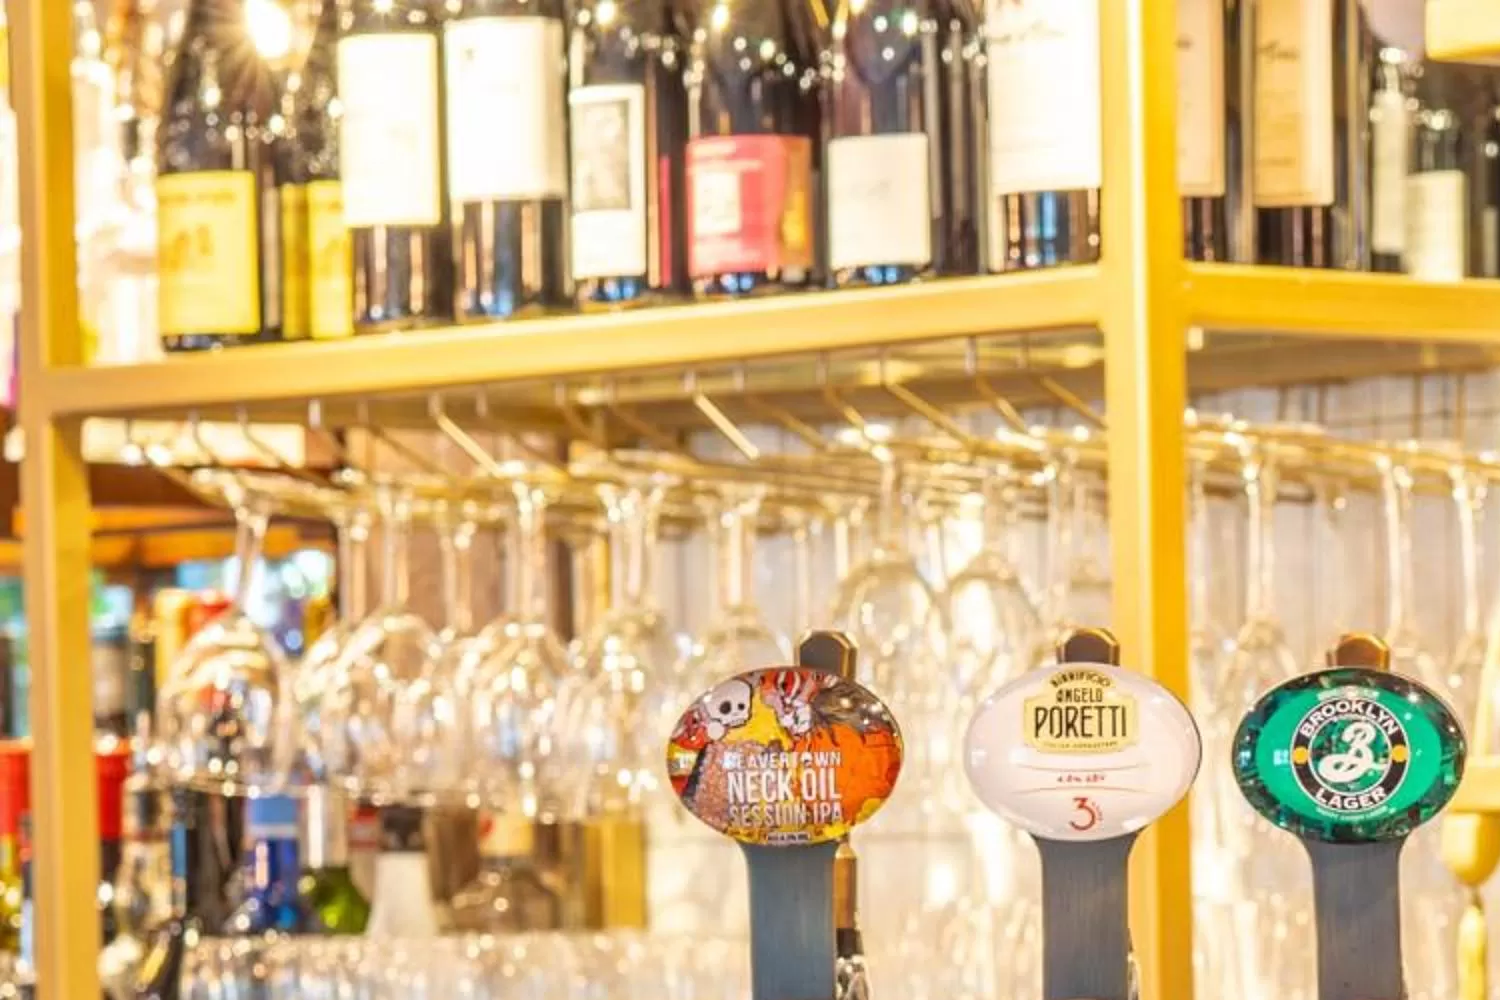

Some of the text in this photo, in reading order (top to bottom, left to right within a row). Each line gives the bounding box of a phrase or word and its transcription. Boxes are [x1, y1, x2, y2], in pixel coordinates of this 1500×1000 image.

[1034, 705, 1126, 738] PORETTI
[1300, 699, 1400, 737] BROOKLYN
[727, 768, 842, 803] NECK OIL
[1316, 786, 1387, 809] LAGER
[729, 802, 843, 827] SESSION IPA
[1069, 797, 1096, 831] 3
